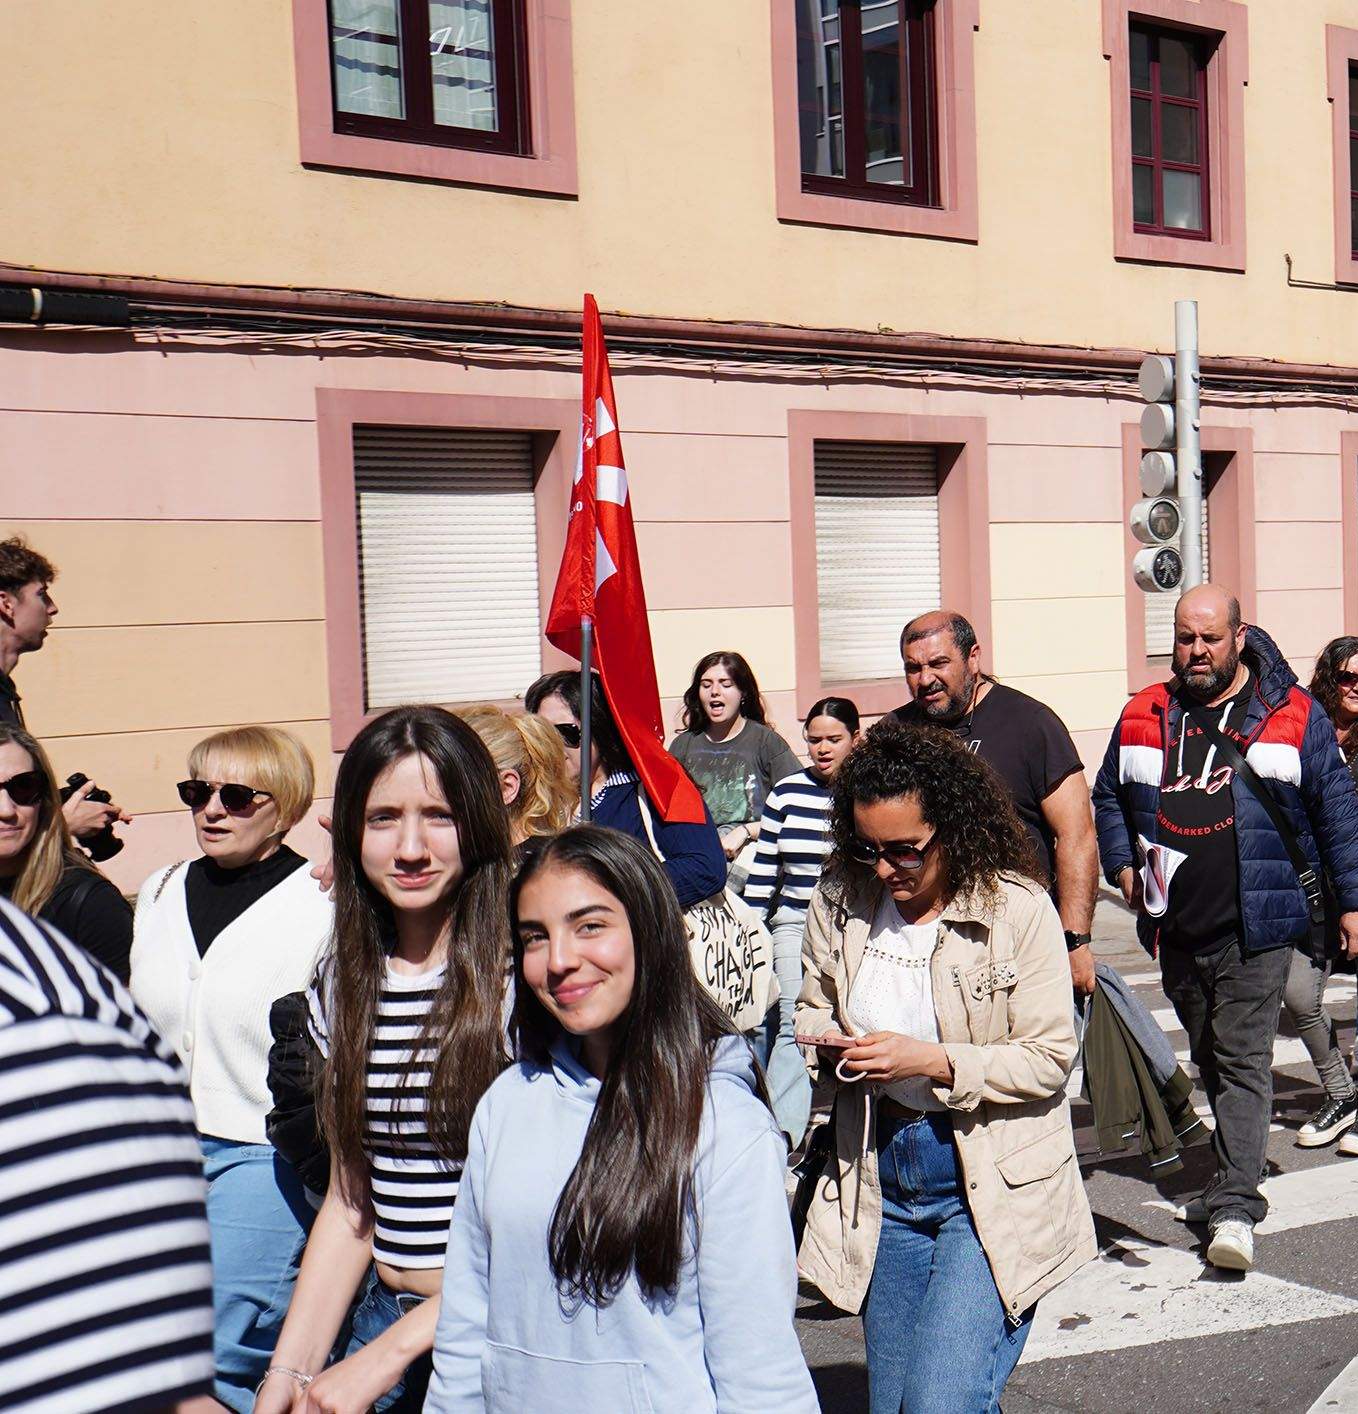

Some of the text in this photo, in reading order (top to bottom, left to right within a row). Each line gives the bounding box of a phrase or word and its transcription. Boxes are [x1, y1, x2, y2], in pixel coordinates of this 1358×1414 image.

[1156, 808, 1234, 836] ADEMARKED CLO
[705, 930, 766, 988] CHAGE
